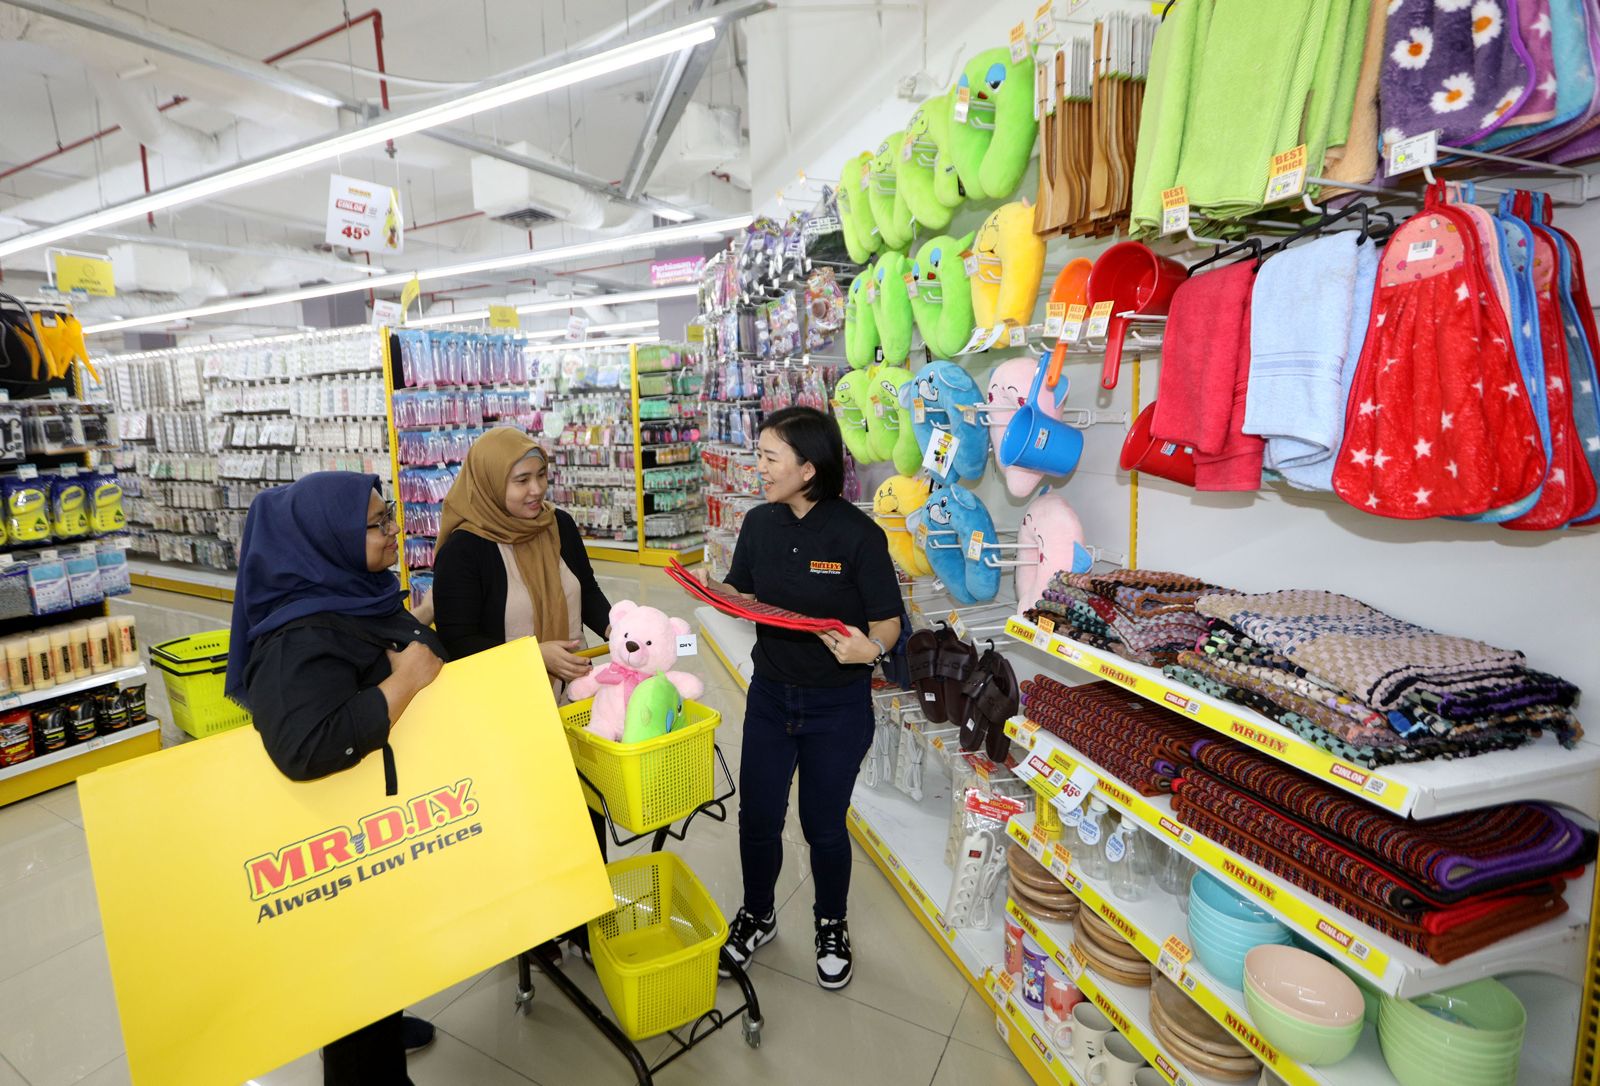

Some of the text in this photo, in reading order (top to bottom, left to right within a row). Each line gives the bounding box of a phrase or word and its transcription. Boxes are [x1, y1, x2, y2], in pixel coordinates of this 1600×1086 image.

[1275, 146, 1303, 165] BEST
[1276, 157, 1302, 174] PRICE
[1163, 186, 1184, 199] BEST
[1165, 196, 1185, 207] PRICE
[1039, 617, 1053, 627] BEST
[1332, 764, 1366, 785] CINLOK
[1079, 822, 1097, 837] Luxury
[257, 822, 483, 924] Always Low Prices
[1318, 920, 1351, 947] CINLOK
[1165, 942, 1186, 961] PRICE
[1169, 936, 1190, 955] BEST
